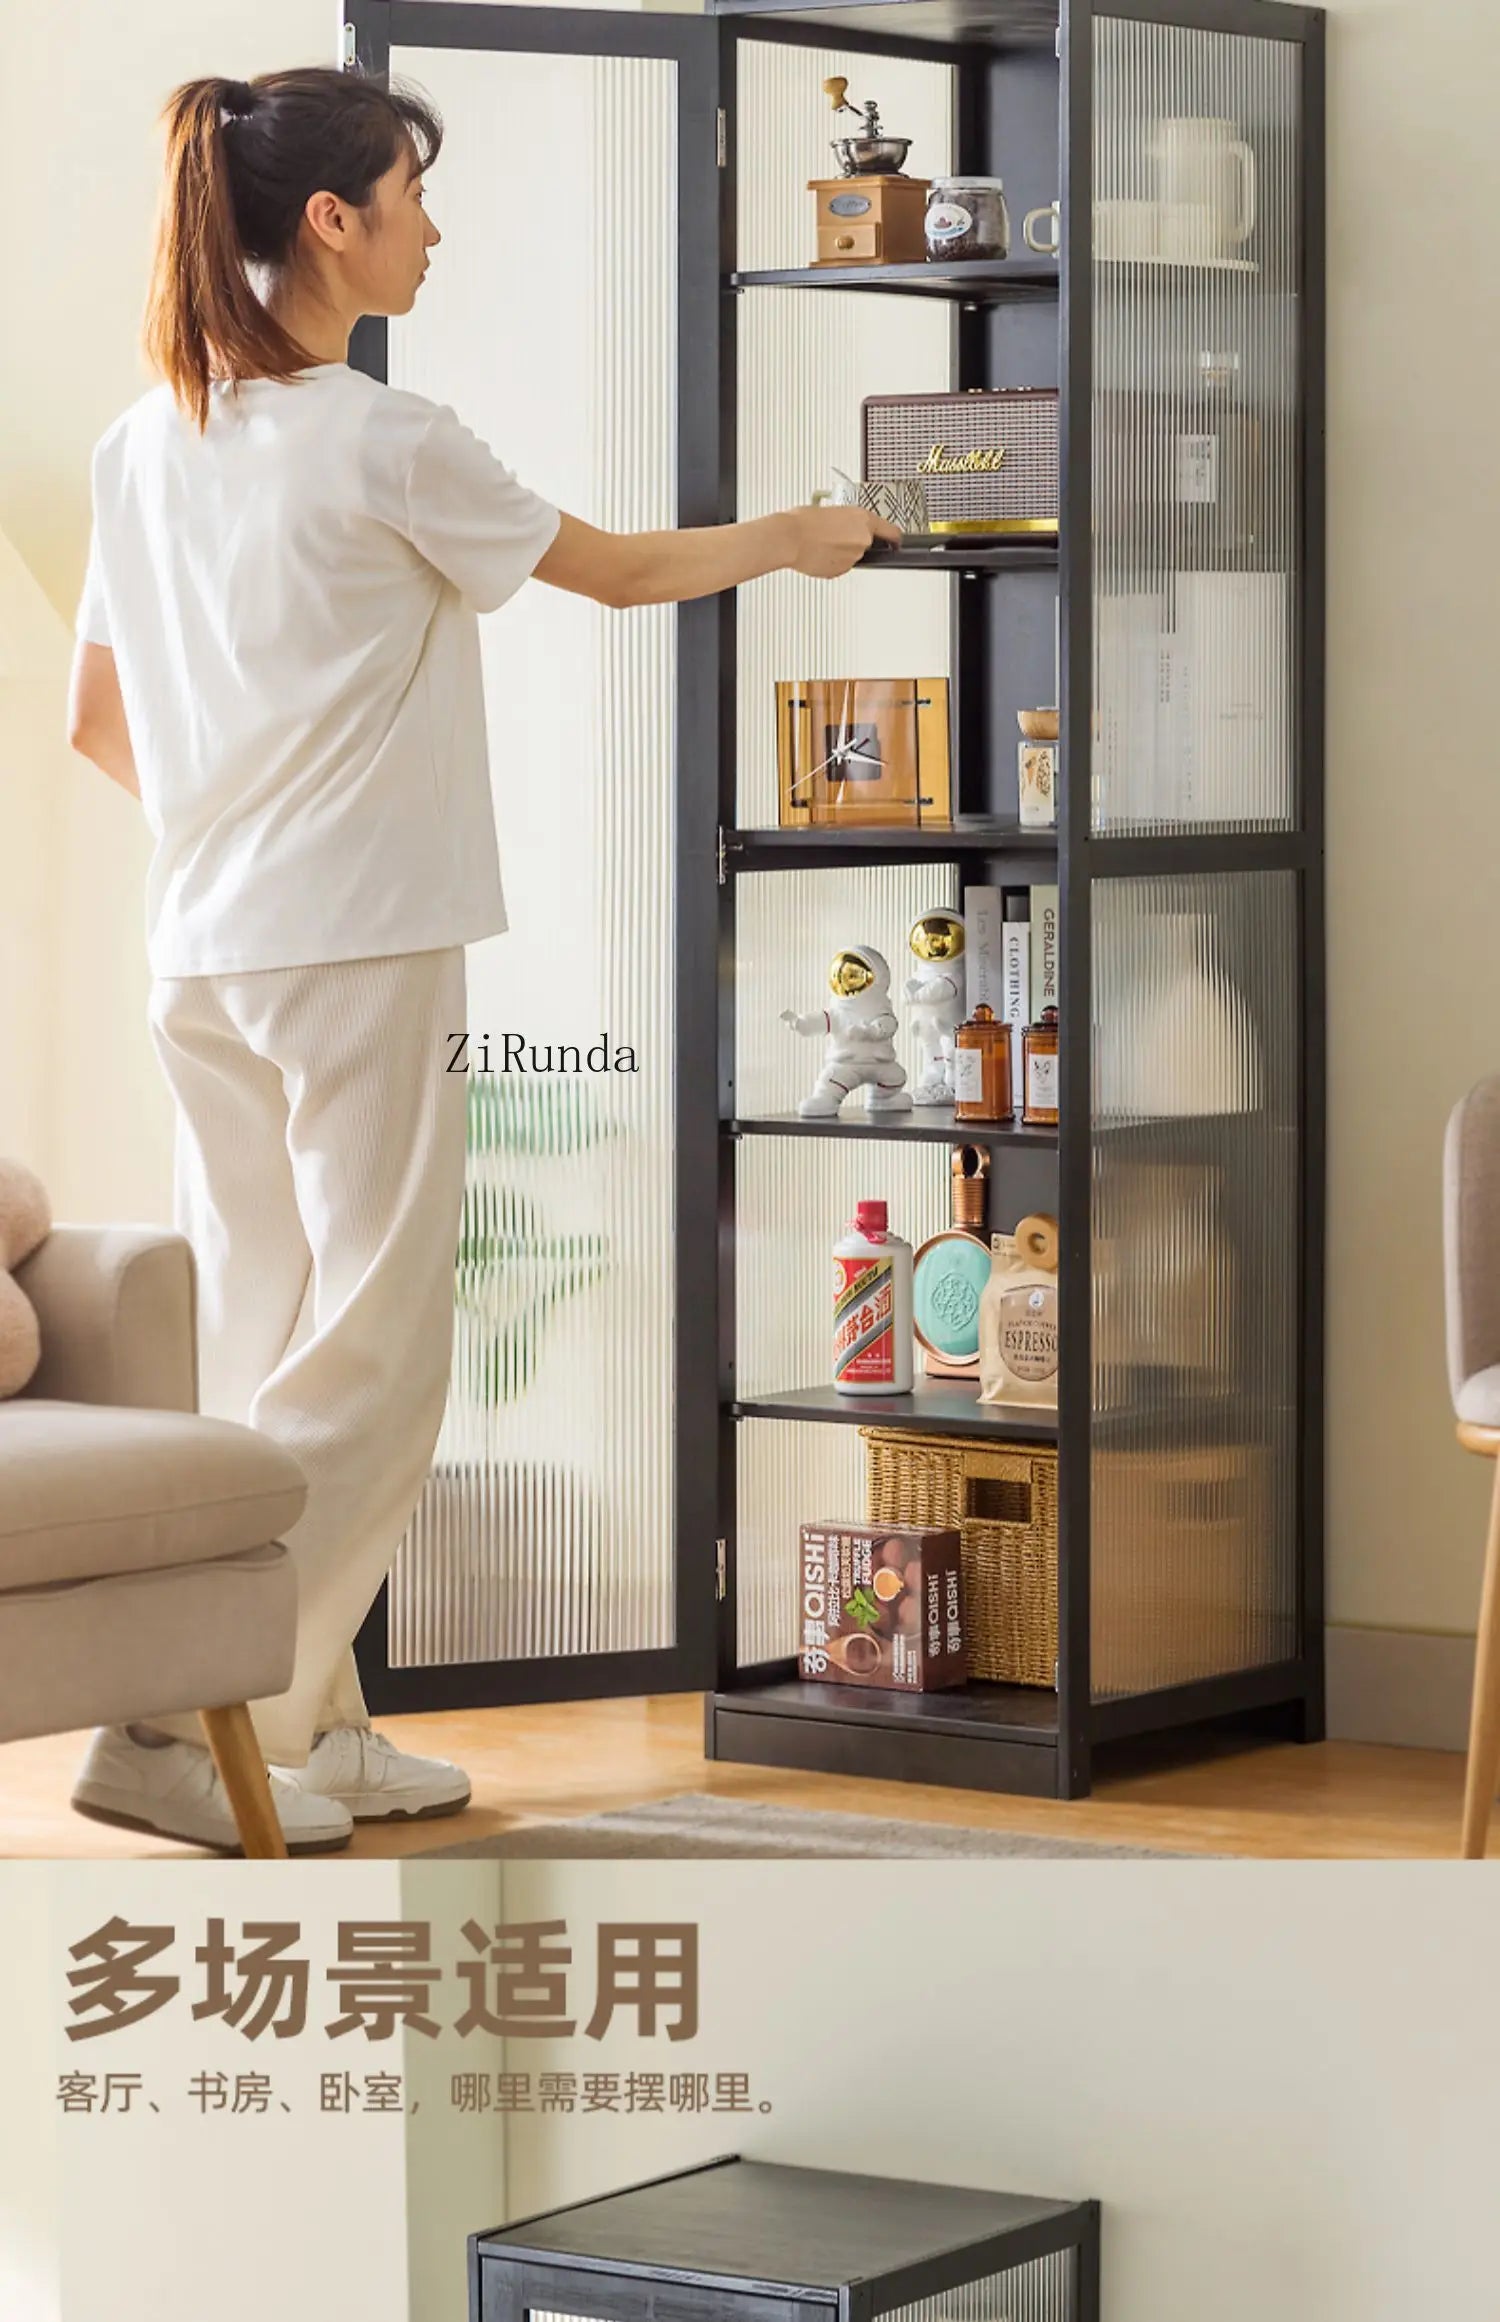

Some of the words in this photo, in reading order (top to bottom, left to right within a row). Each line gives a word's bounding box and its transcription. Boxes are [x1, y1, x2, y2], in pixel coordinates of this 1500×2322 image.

[1009, 936, 1020, 1018] CLOTHING
[1043, 908, 1055, 998] GERALDINE
[862, 1539, 872, 1586] FUDGE
